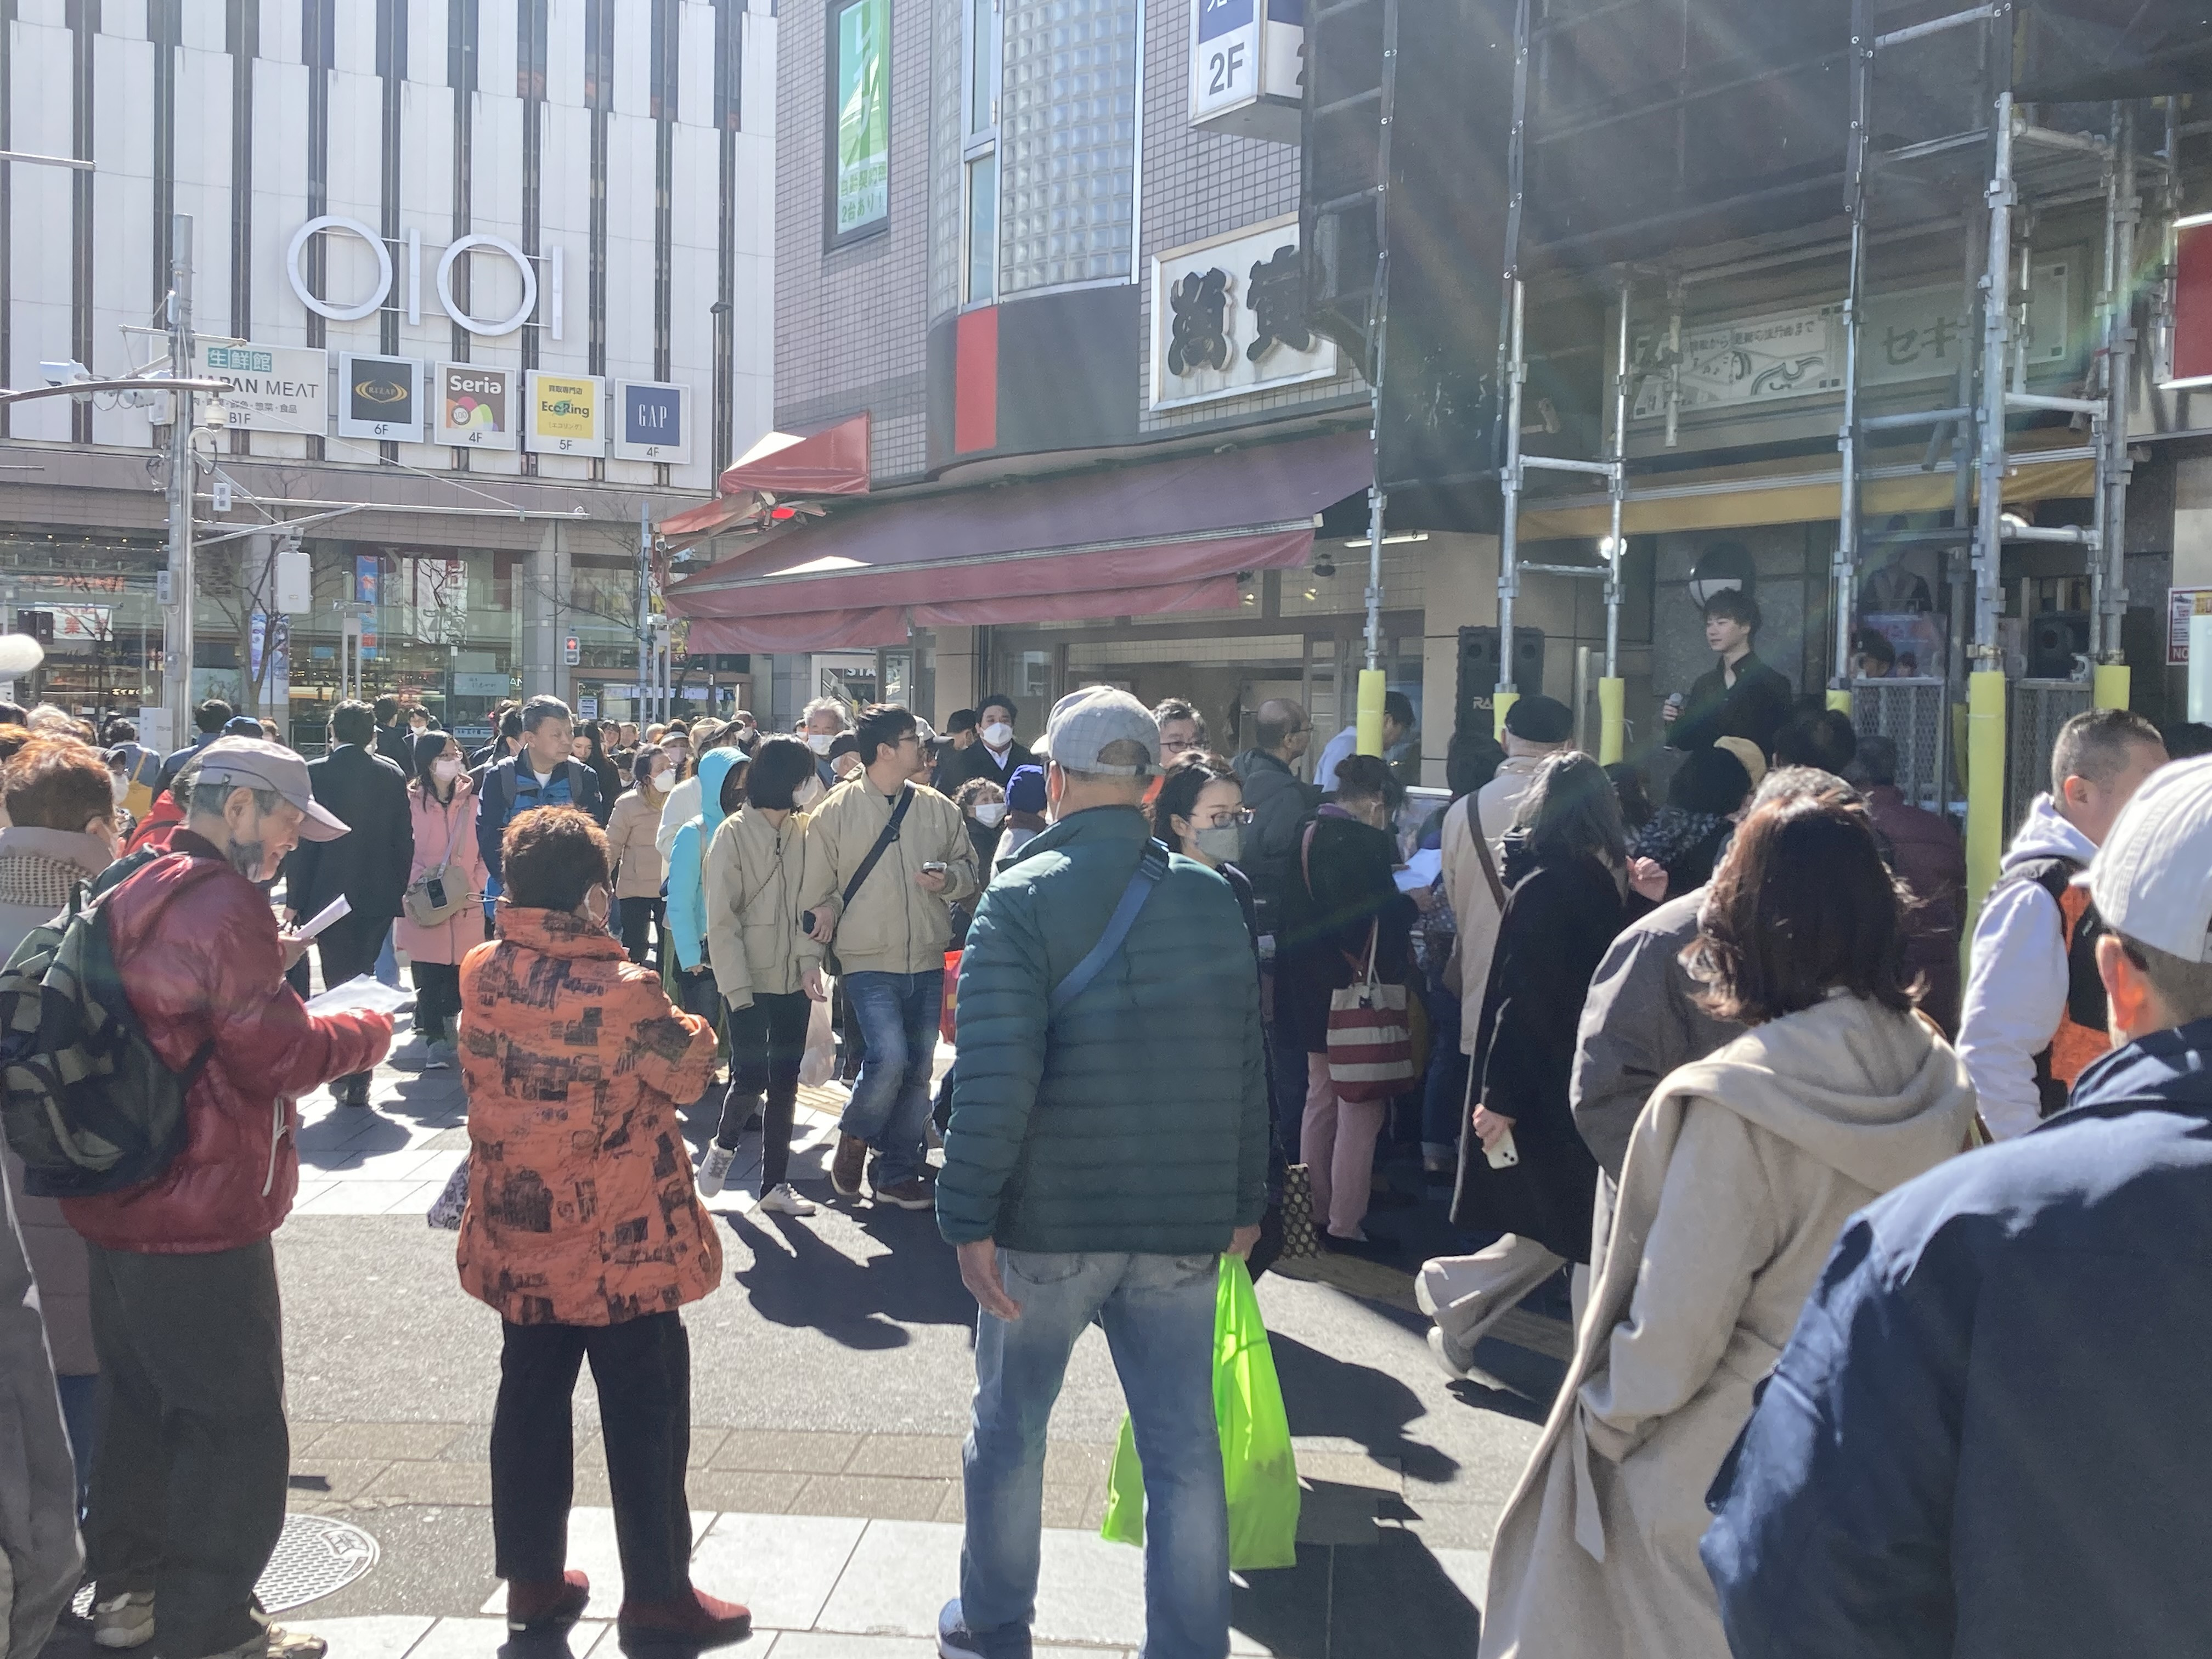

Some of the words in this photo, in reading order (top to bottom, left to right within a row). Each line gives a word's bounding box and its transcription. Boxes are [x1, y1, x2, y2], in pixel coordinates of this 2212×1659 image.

[1209, 42, 1245, 96] 2F
[208, 348, 272, 372] 生鮮館
[266, 380, 319, 398] MEAT
[450, 375, 502, 394] Seria
[549, 385, 583, 395] 買取専門店
[368, 386, 398, 396] RIZAP
[229, 412, 251, 425] B1F
[454, 410, 467, 420] 100
[638, 404, 668, 428] GAP
[374, 424, 389, 435] 6F
[469, 432, 483, 443] 4F
[559, 439, 573, 450] 5F
[646, 447, 659, 458] 4F
